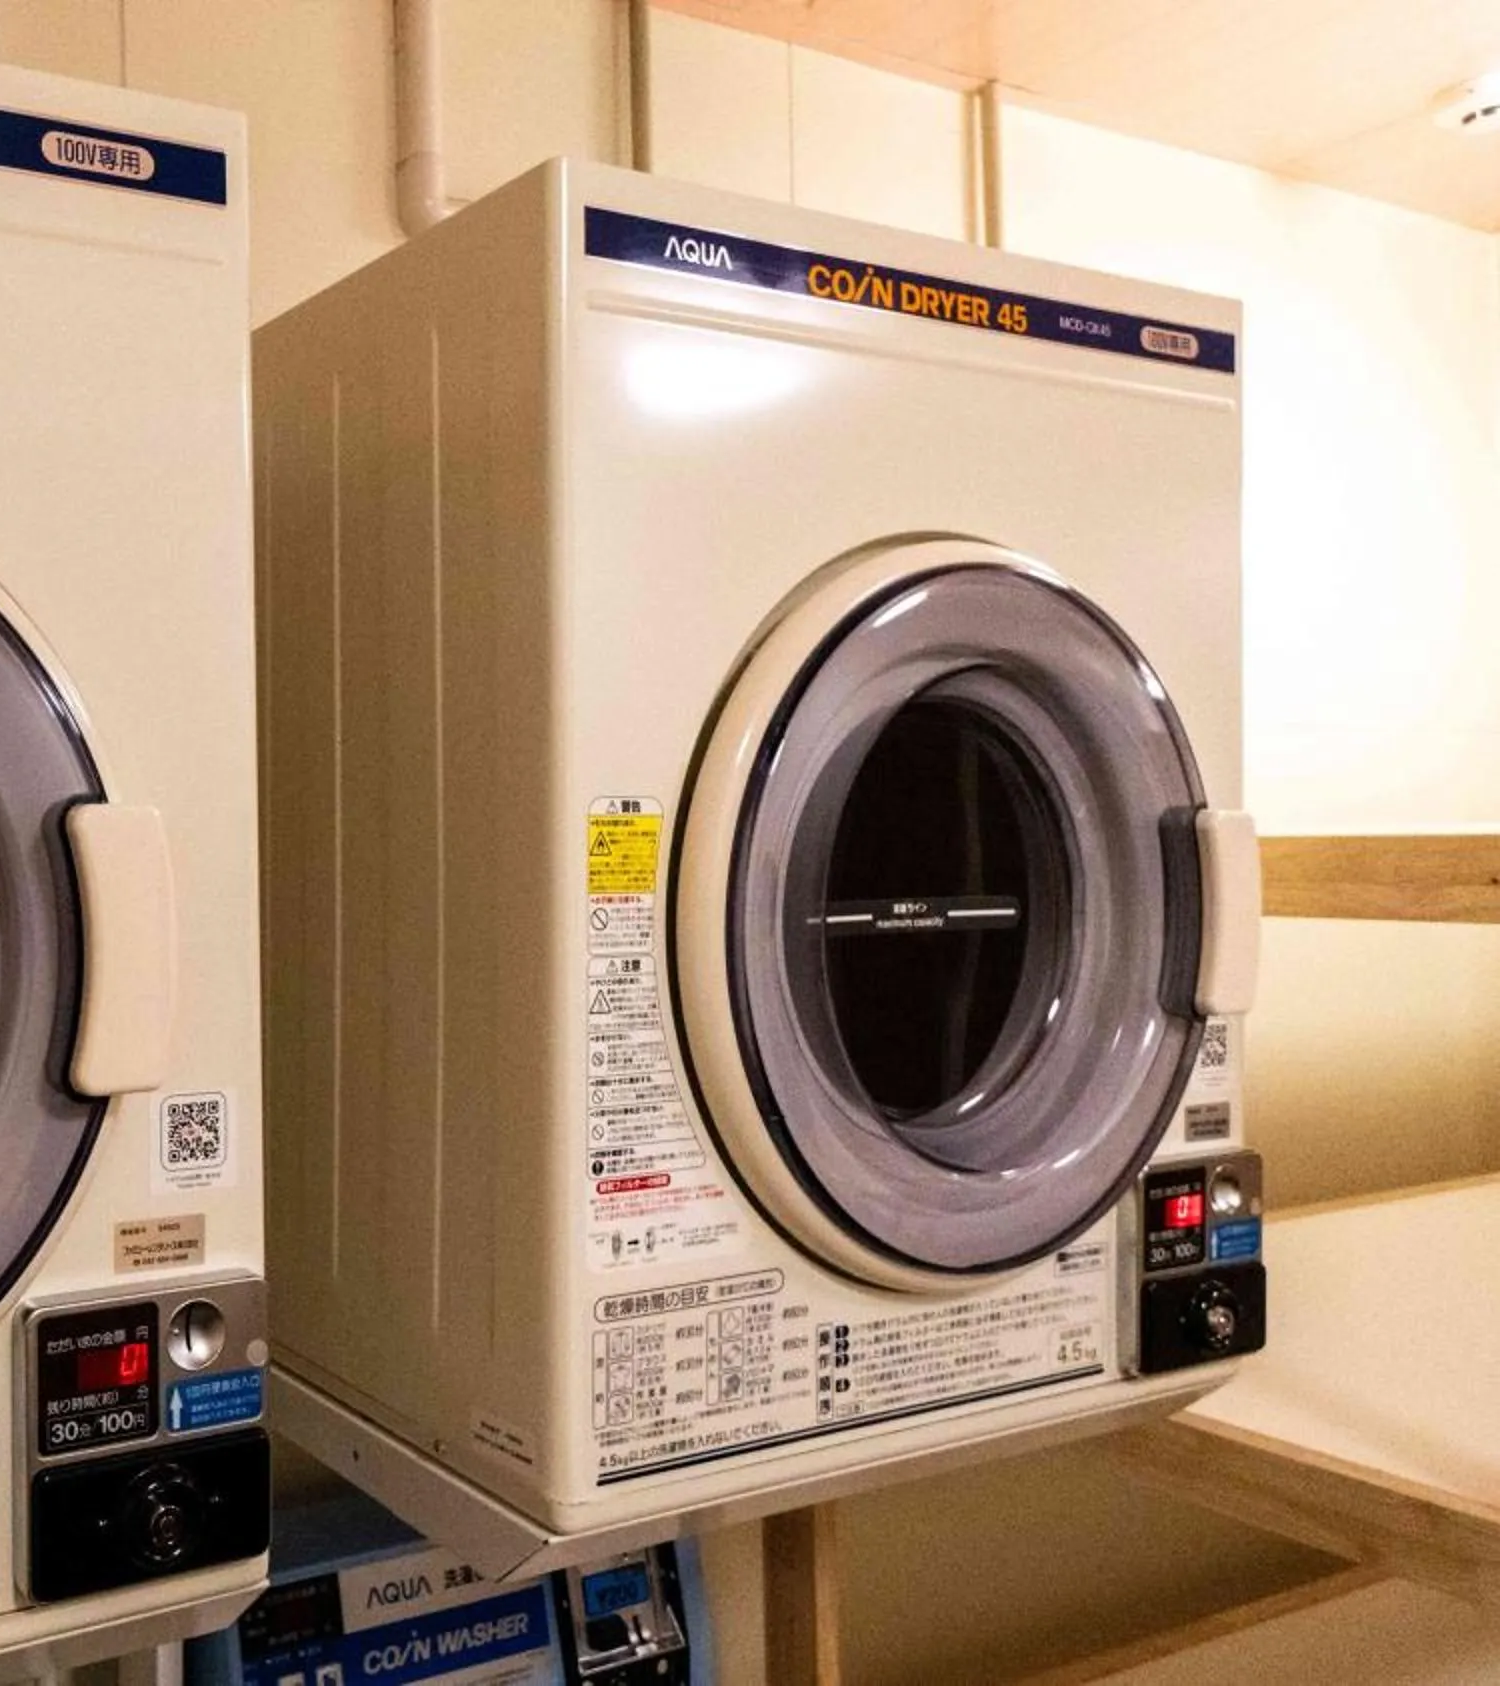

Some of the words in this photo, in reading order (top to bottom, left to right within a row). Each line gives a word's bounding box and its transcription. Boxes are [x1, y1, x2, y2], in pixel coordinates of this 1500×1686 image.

[55, 137, 141, 174] 100V専用
[664, 236, 733, 270] AQUA
[900, 283, 990, 327] DRYER
[997, 303, 1028, 334] 45
[121, 1343, 137, 1377] 0
[366, 1576, 433, 1609] AQUA
[437, 1612, 530, 1656] WASHER
